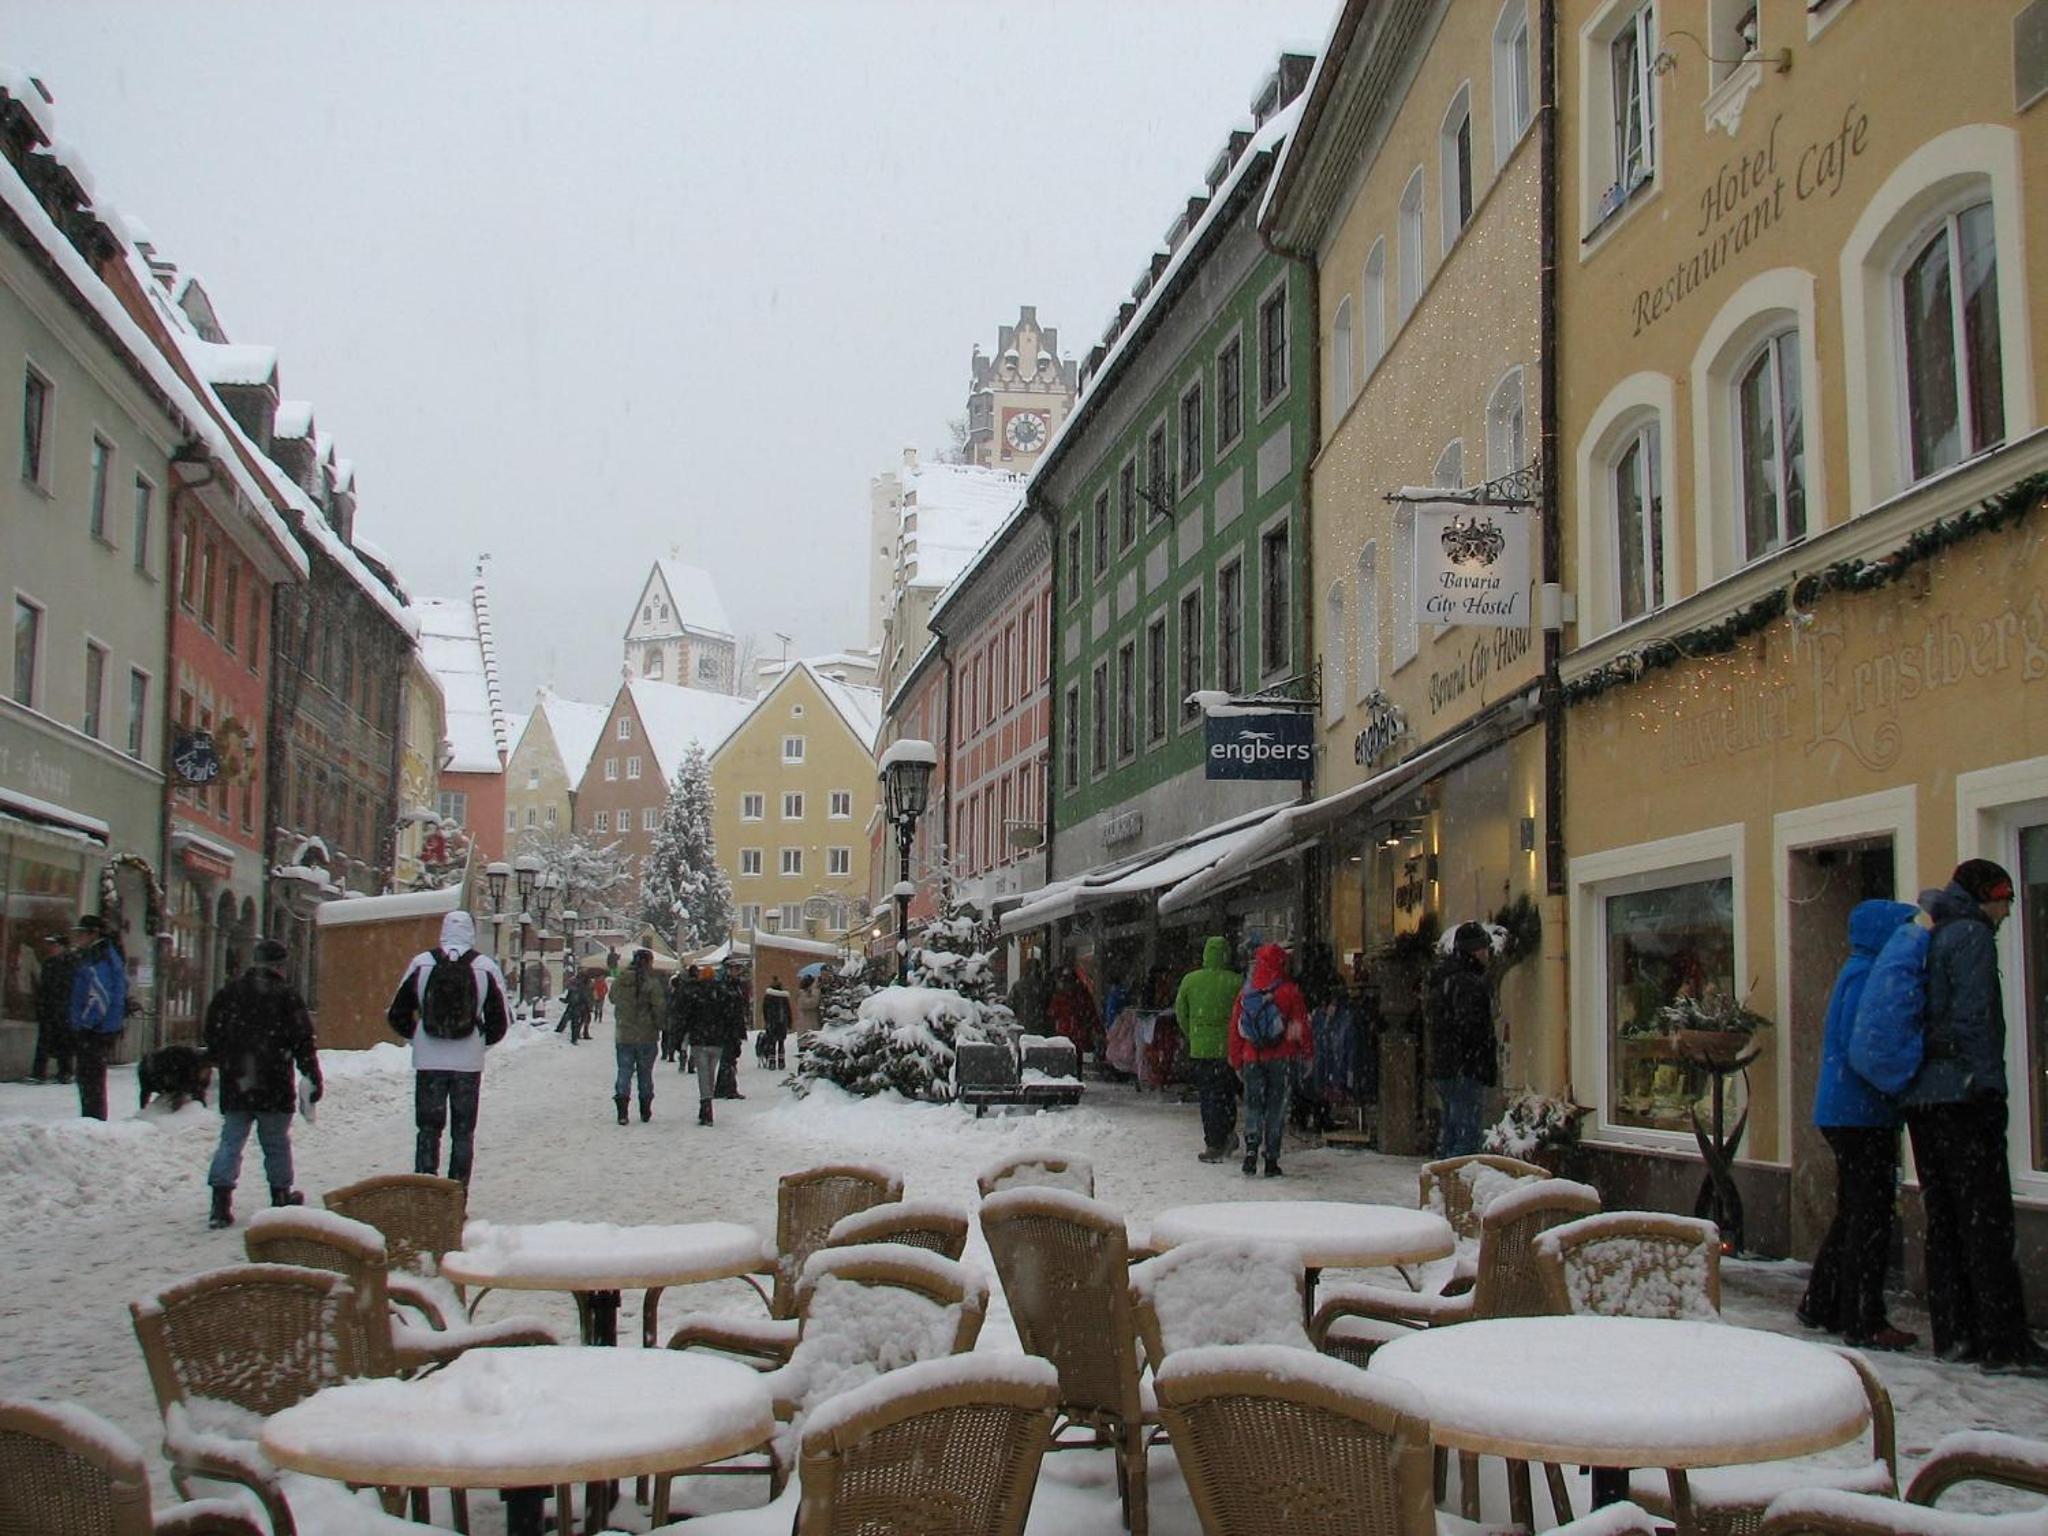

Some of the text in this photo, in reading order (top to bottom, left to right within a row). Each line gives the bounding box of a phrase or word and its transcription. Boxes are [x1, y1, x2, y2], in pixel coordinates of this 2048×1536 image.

[1698, 114, 1782, 236] Hotel
[1632, 183, 1787, 337] Restaurant
[1440, 571, 1501, 589] Bavaria
[1426, 592, 1519, 622] City Hostel
[1210, 738, 1310, 764] engbers
